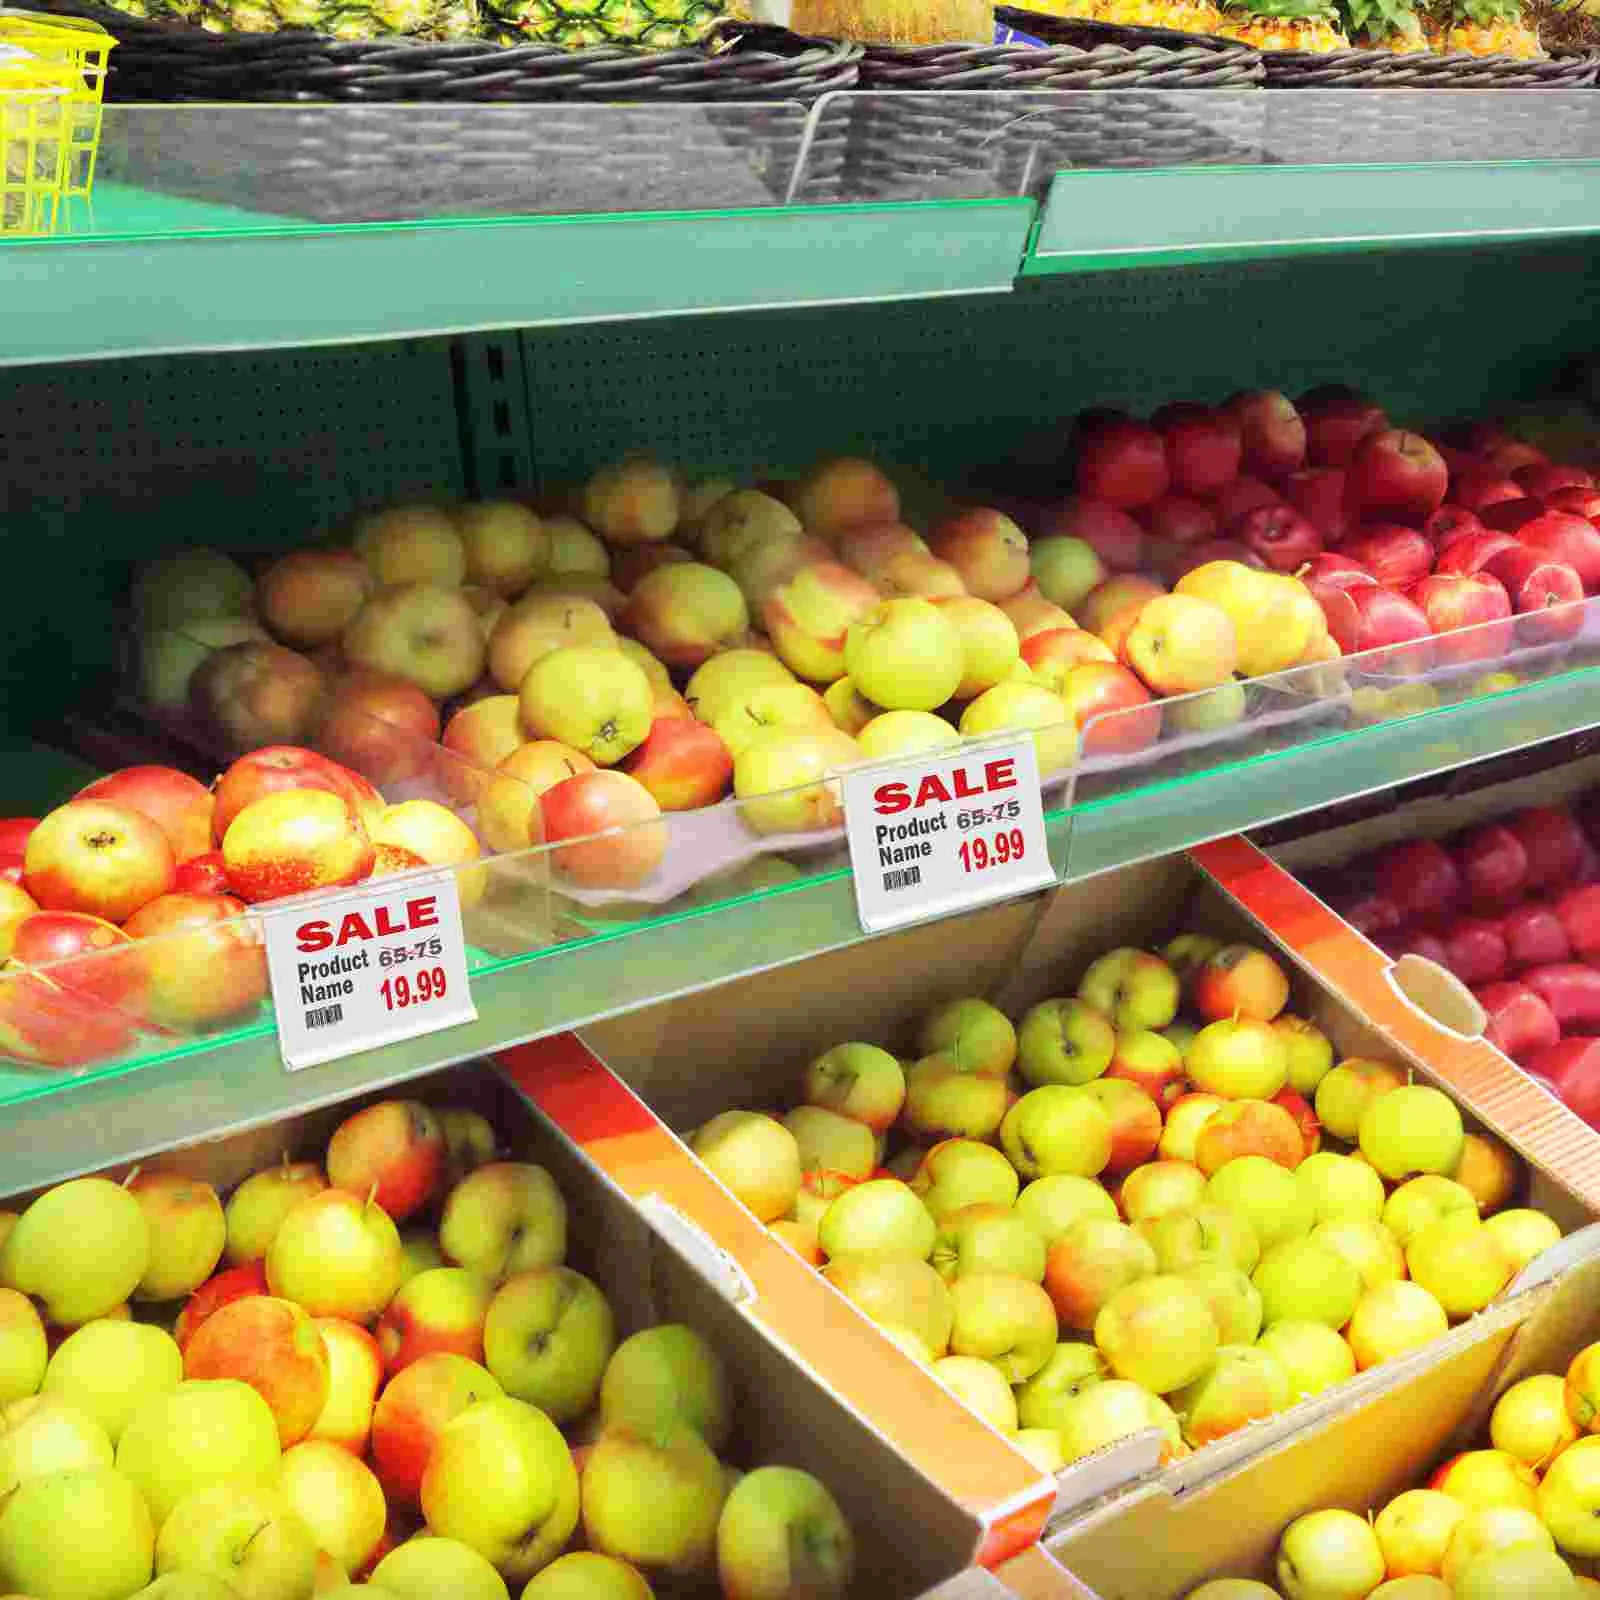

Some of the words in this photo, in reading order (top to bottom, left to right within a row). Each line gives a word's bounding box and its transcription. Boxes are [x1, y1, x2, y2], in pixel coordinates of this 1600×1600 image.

[874, 758, 1017, 815] SALE
[876, 812, 947, 845] Product
[957, 800, 1021, 830] 65.75
[878, 841, 932, 867] Name
[959, 828, 1025, 873] 19.99
[296, 896, 439, 953] SALE
[297, 949, 369, 983] Product
[378, 938, 443, 967] 65.75
[301, 979, 354, 1005] Name
[380, 966, 447, 1011] 19.99
